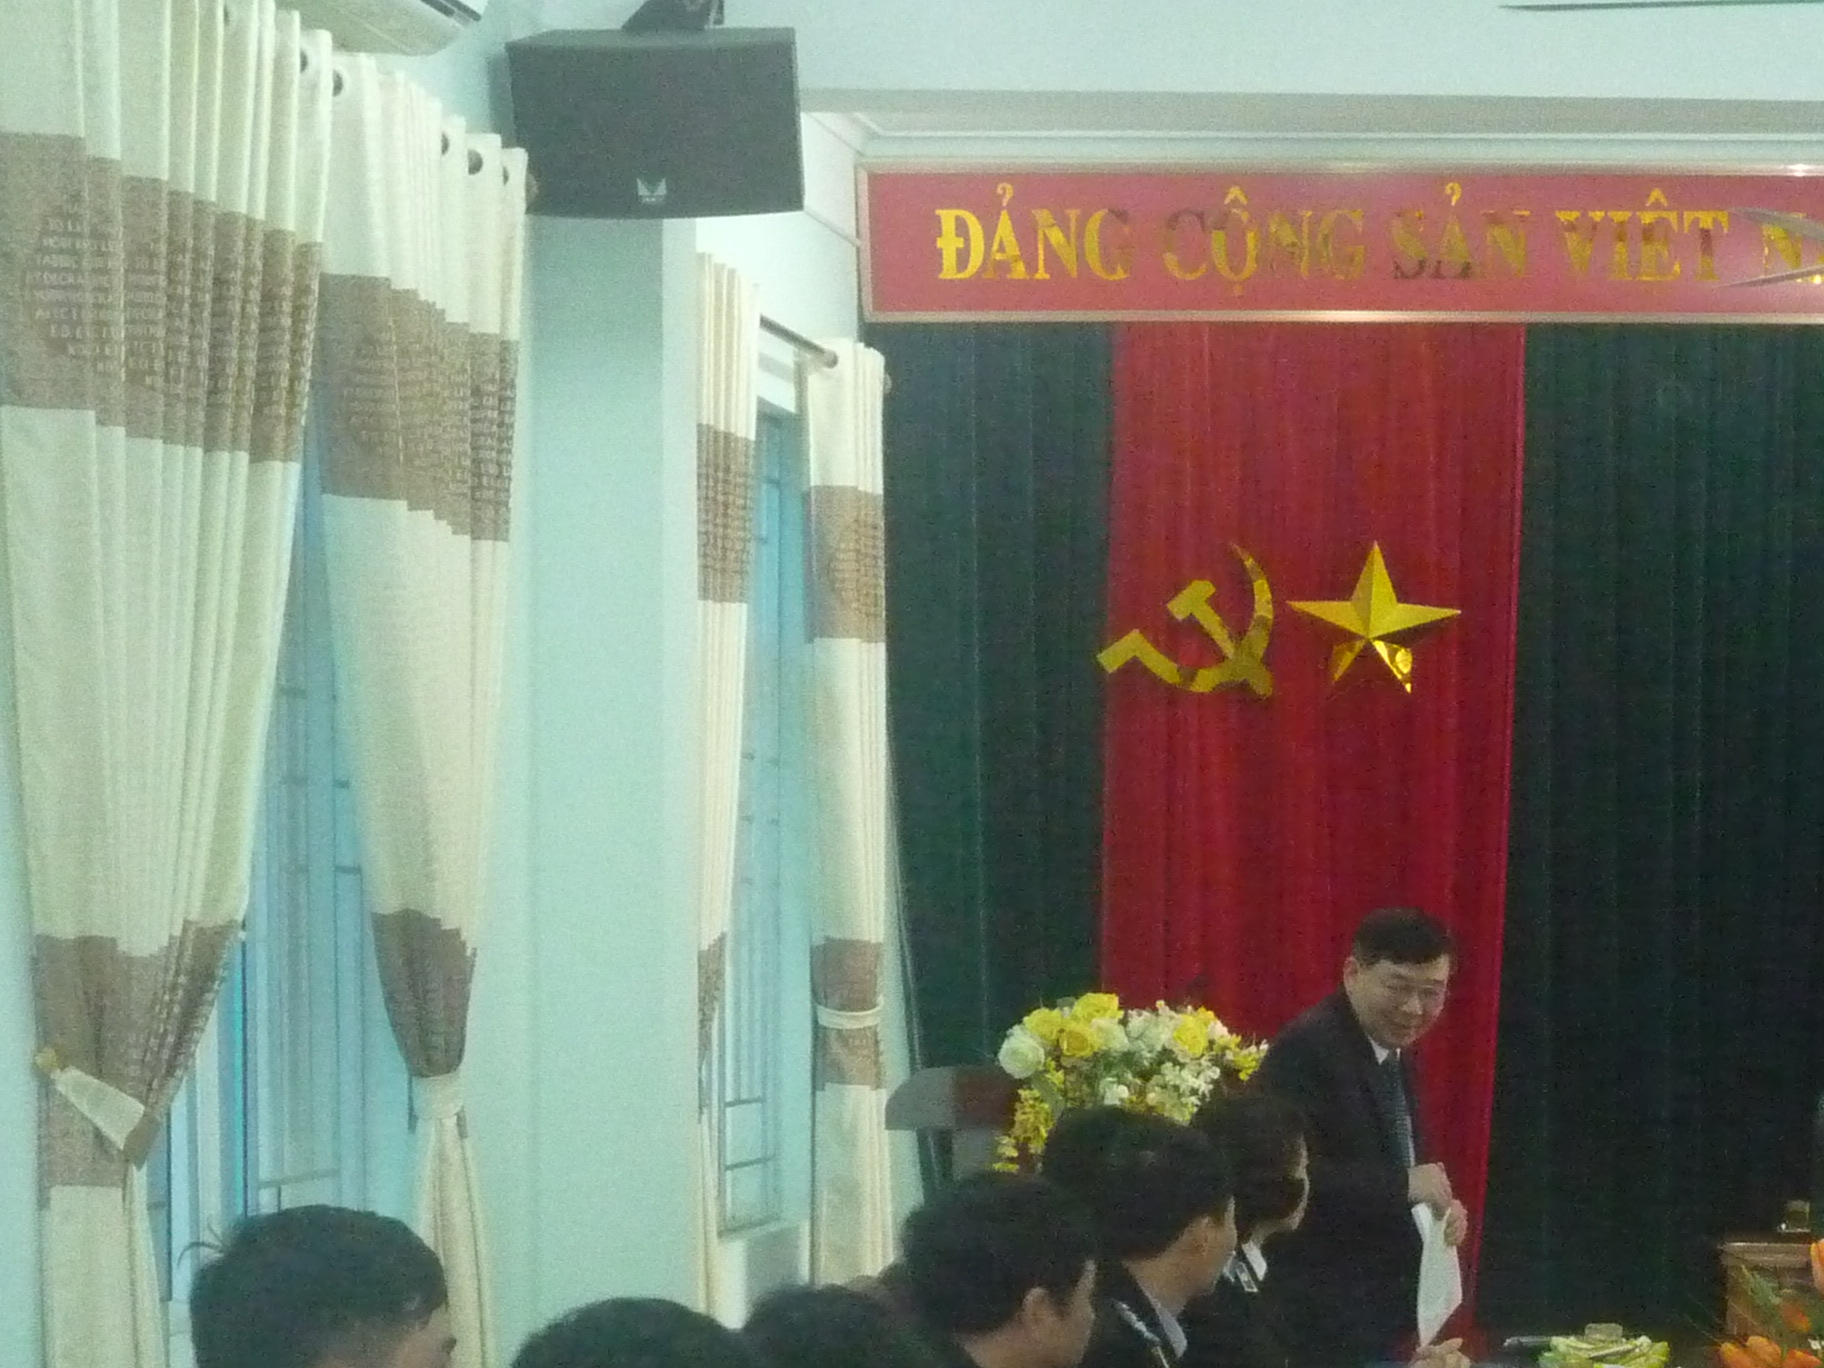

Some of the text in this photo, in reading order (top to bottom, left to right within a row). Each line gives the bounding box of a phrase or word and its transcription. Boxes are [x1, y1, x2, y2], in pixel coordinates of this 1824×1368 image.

[935, 182, 1136, 281] ĐẢNG
[1162, 185, 1367, 296] CỘNG
[1388, 181, 1532, 281] SẢN
